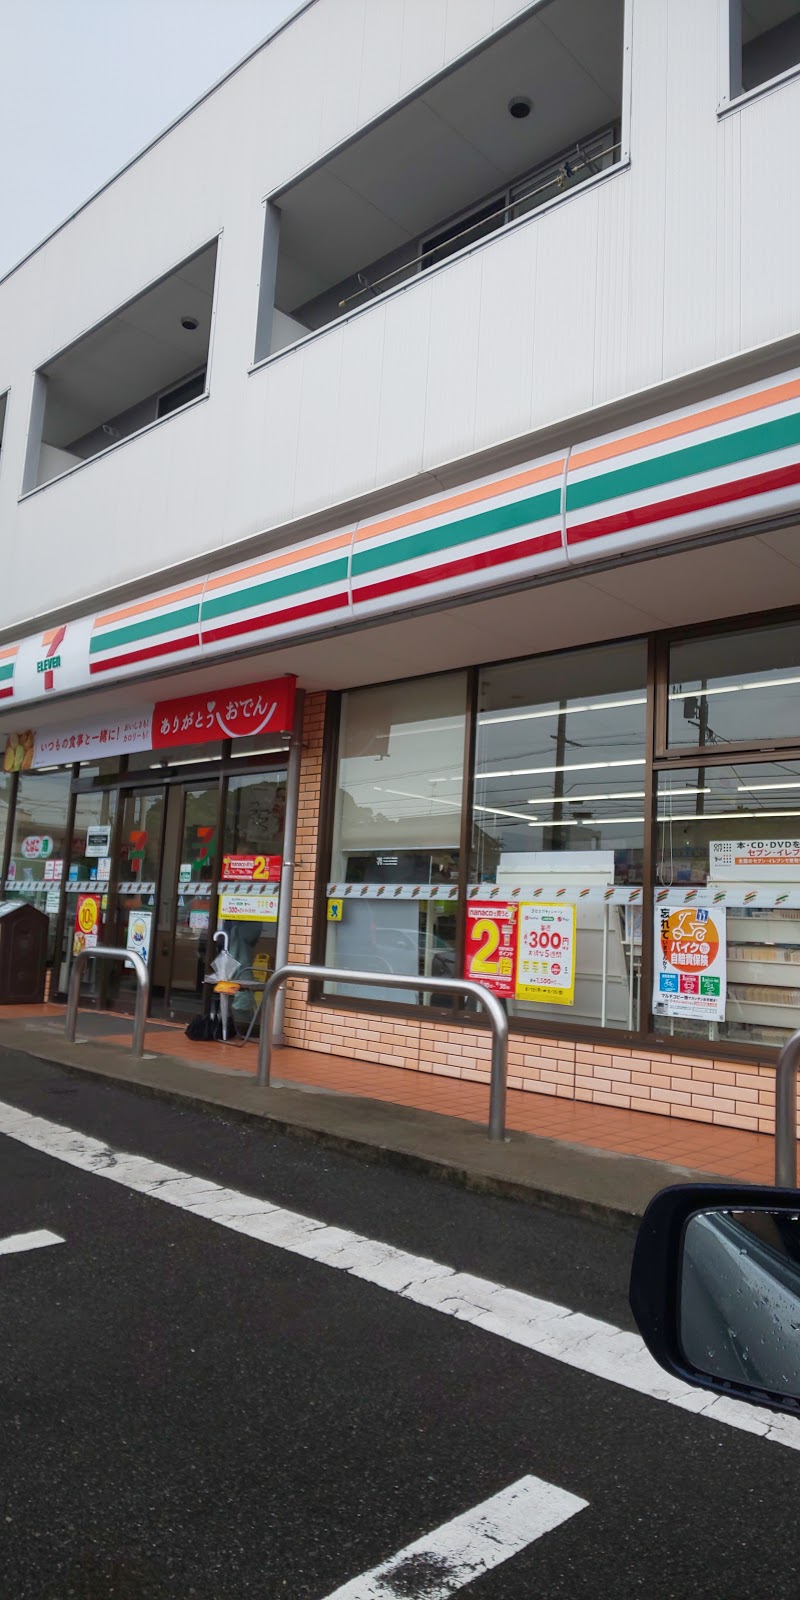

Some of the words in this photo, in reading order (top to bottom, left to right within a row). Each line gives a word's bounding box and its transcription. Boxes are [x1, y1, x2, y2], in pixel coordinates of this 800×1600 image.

[41, 625, 67, 690] 7
[160, 711, 215, 735] ありがとう
[225, 695, 269, 721] おでん
[253, 856, 266, 879] 2
[470, 918, 500, 975] 2
[671, 942, 700, 953] バイク
